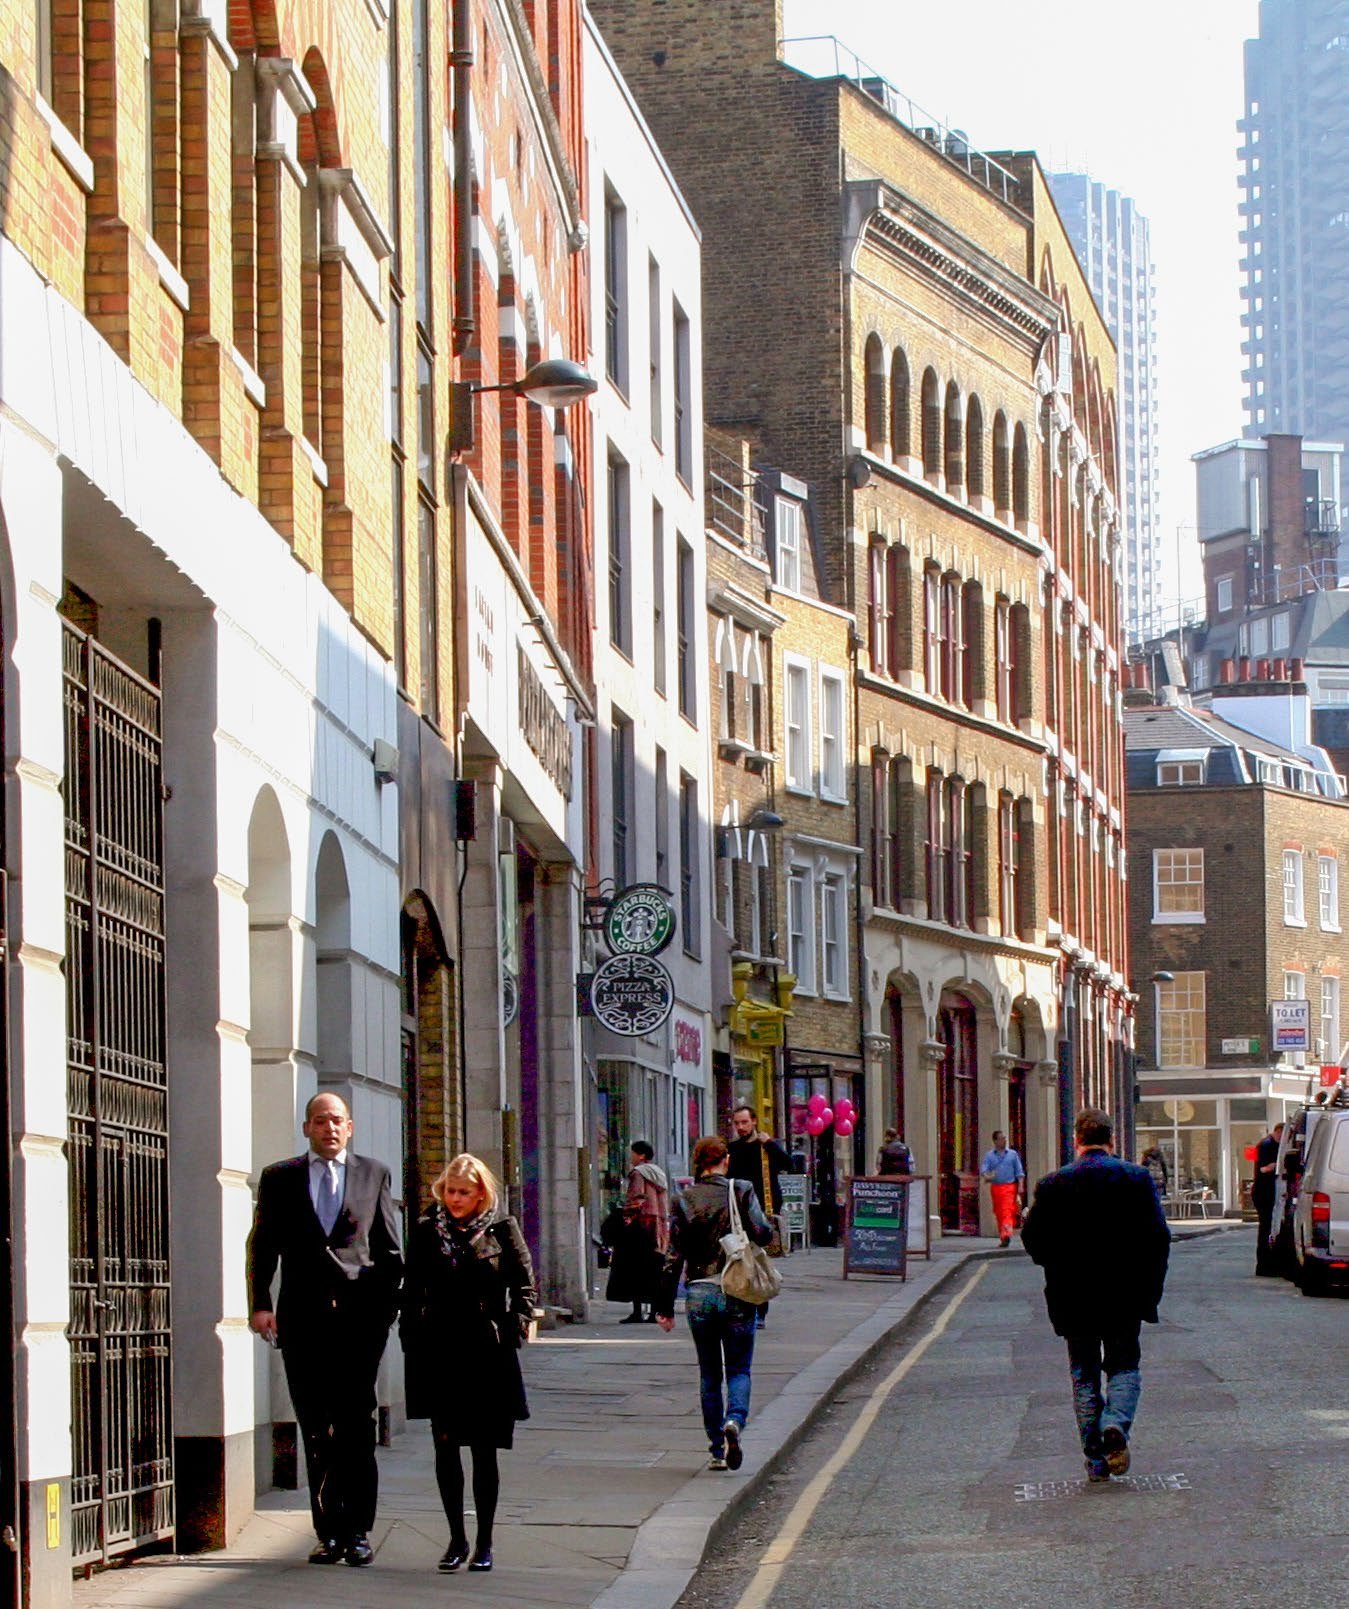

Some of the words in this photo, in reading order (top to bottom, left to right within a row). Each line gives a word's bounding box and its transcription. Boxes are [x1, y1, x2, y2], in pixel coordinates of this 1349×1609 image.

[614, 895, 668, 921] STARBUCKS
[617, 937, 657, 952] COFFEE
[613, 982, 650, 992] PIZZA
[603, 992, 662, 1004] EXPRESS
[1276, 1008, 1288, 1018] TO
[1290, 1008, 1306, 1018] LET
